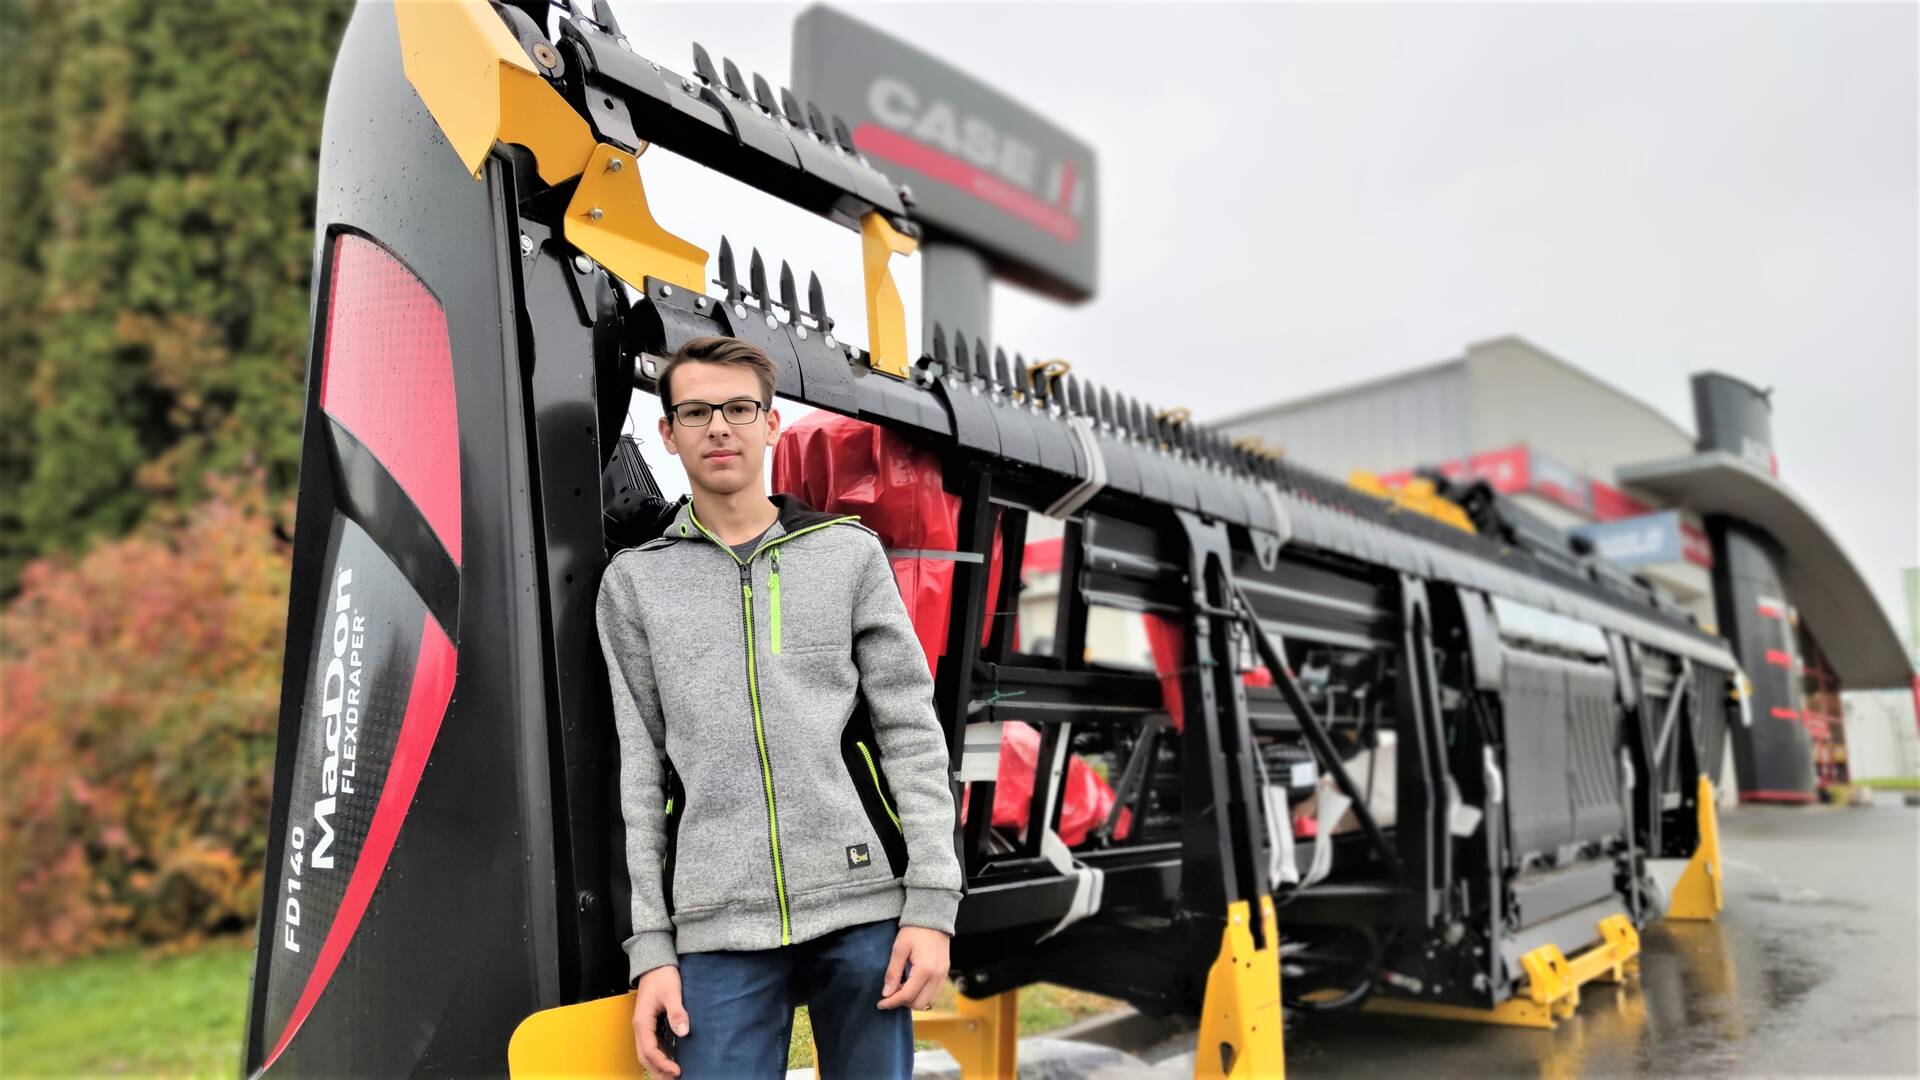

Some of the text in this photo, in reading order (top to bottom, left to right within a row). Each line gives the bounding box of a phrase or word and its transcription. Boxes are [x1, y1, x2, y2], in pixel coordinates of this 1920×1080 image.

[867, 77, 1038, 187] CASE
[312, 569, 352, 869] MacDon
[341, 615, 364, 794] FLEXDRAPER
[285, 827, 305, 953] FD140
